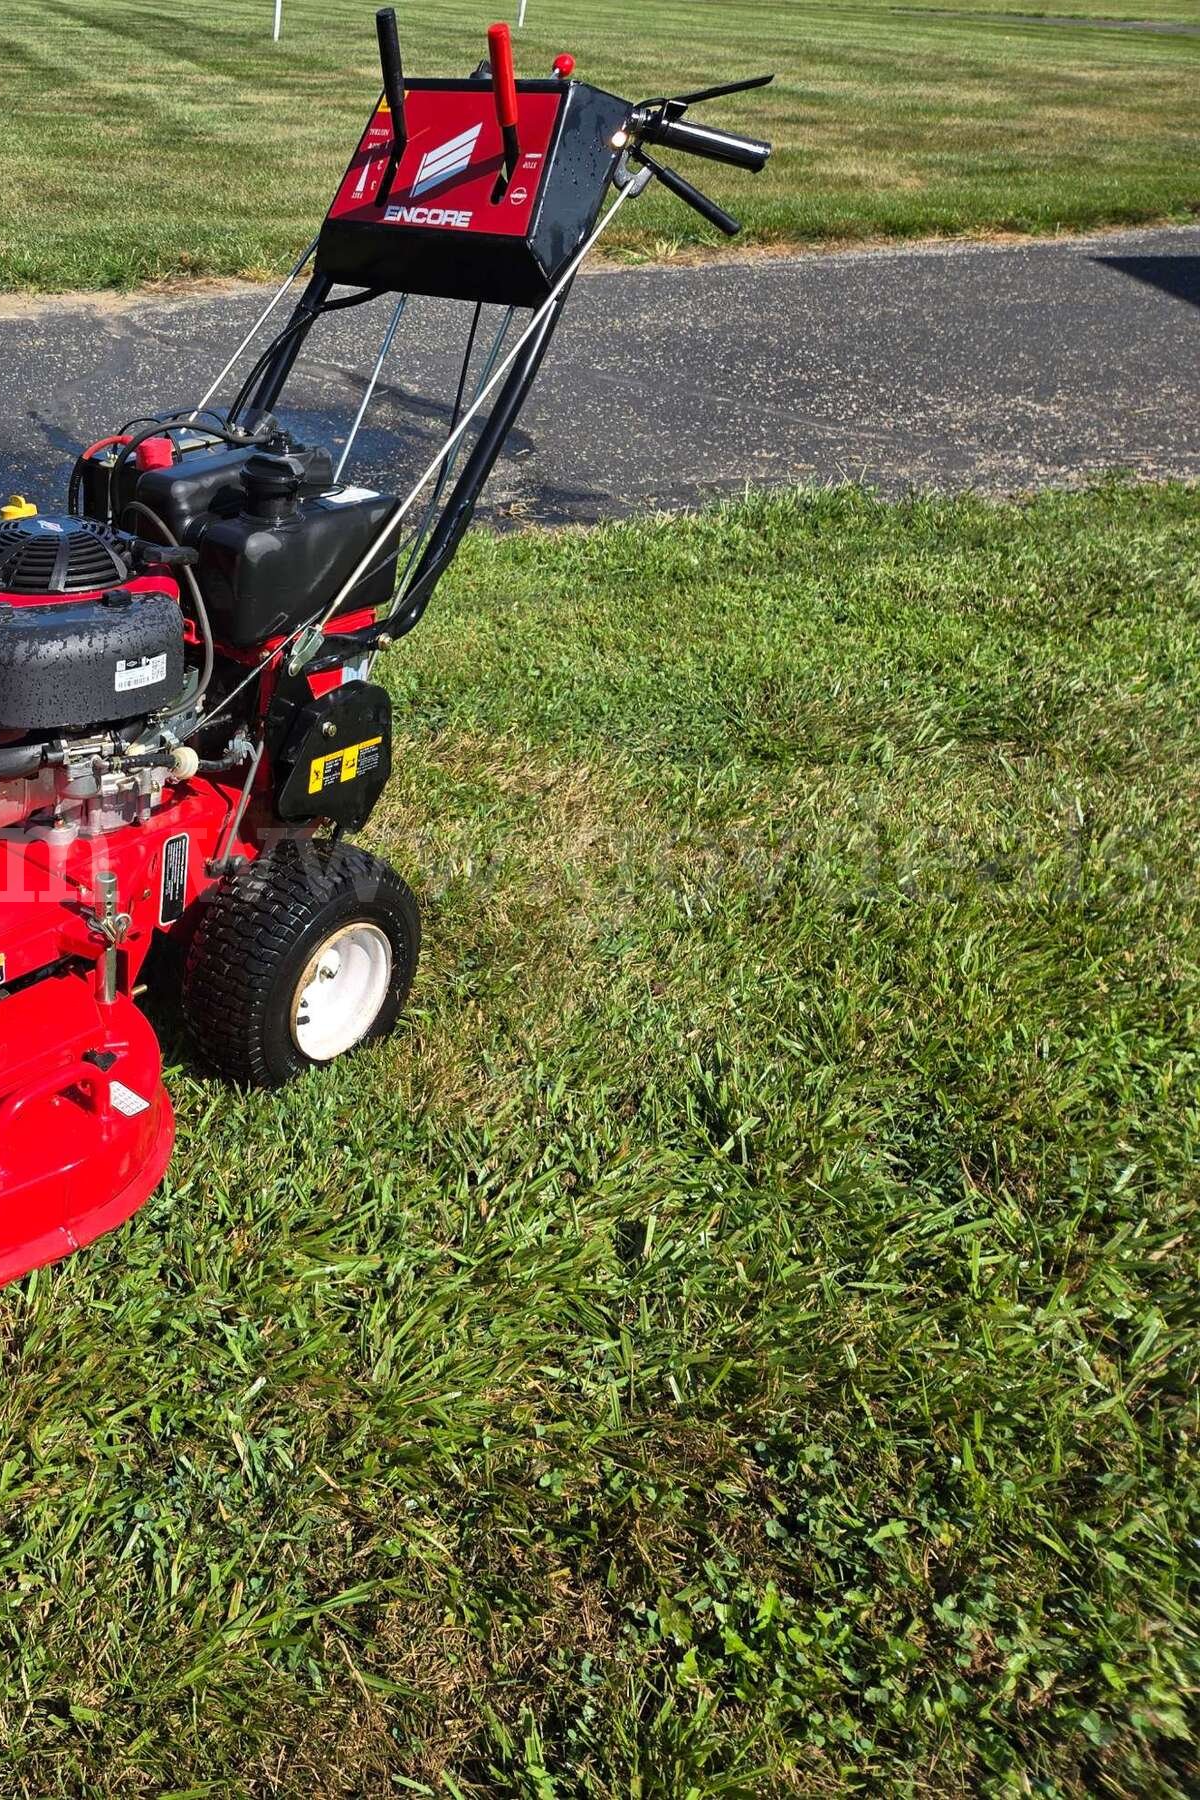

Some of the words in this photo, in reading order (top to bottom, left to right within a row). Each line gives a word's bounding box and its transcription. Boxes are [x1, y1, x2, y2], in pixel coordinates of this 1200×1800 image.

[522, 161, 538, 169] STOP
[370, 180, 377, 191] 3
[384, 205, 473, 227] ENCORE
